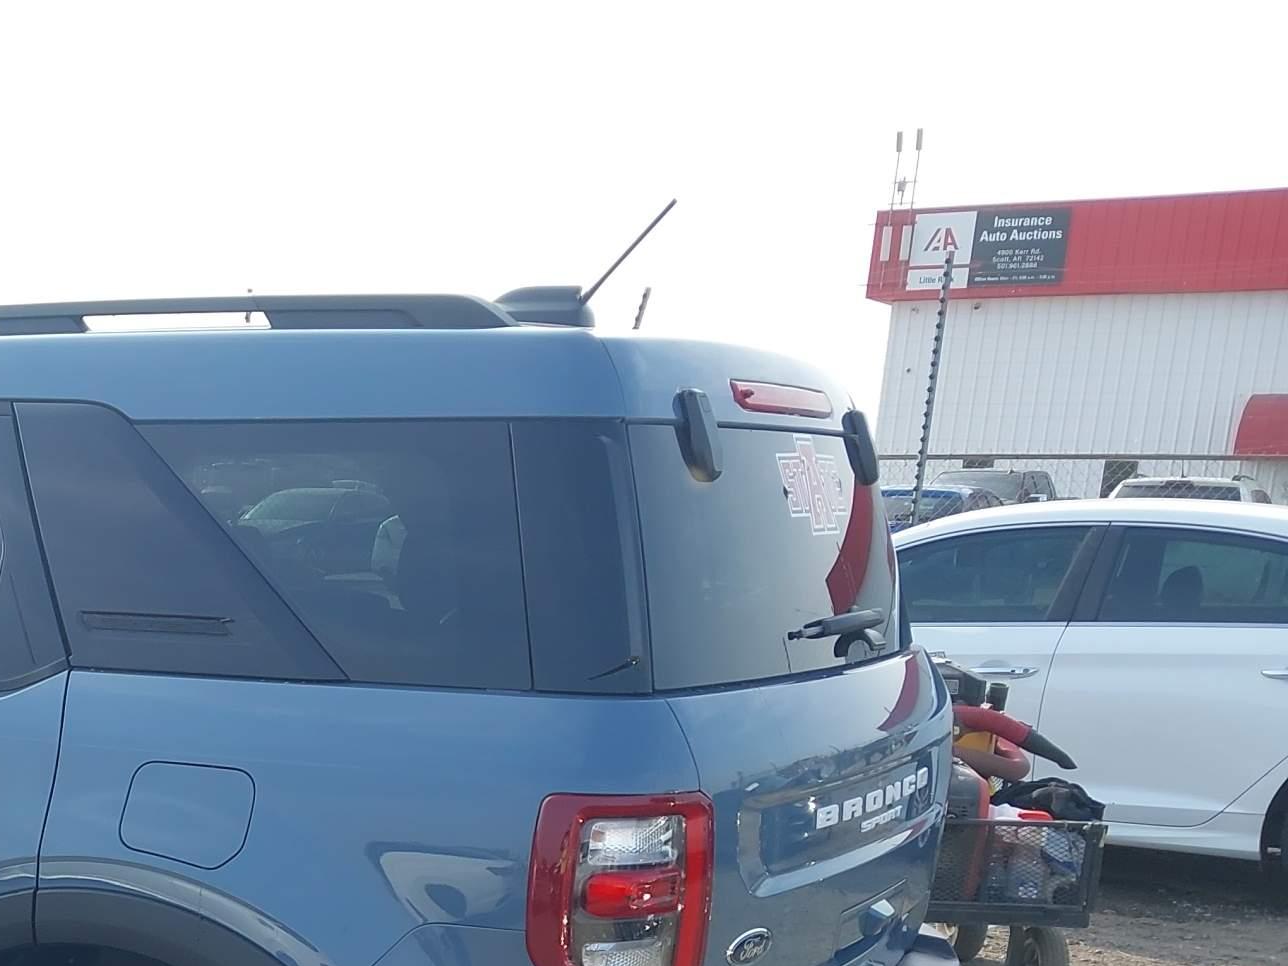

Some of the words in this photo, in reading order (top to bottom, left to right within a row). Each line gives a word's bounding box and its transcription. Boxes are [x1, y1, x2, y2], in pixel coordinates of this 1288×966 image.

[994, 216, 1053, 228] Insurance
[980, 231, 1007, 242] Auto
[1009, 228, 1063, 241] Auctions
[816, 766, 929, 830] BRONCO
[860, 805, 903, 833] SPORT
[739, 936, 767, 961] Ford
